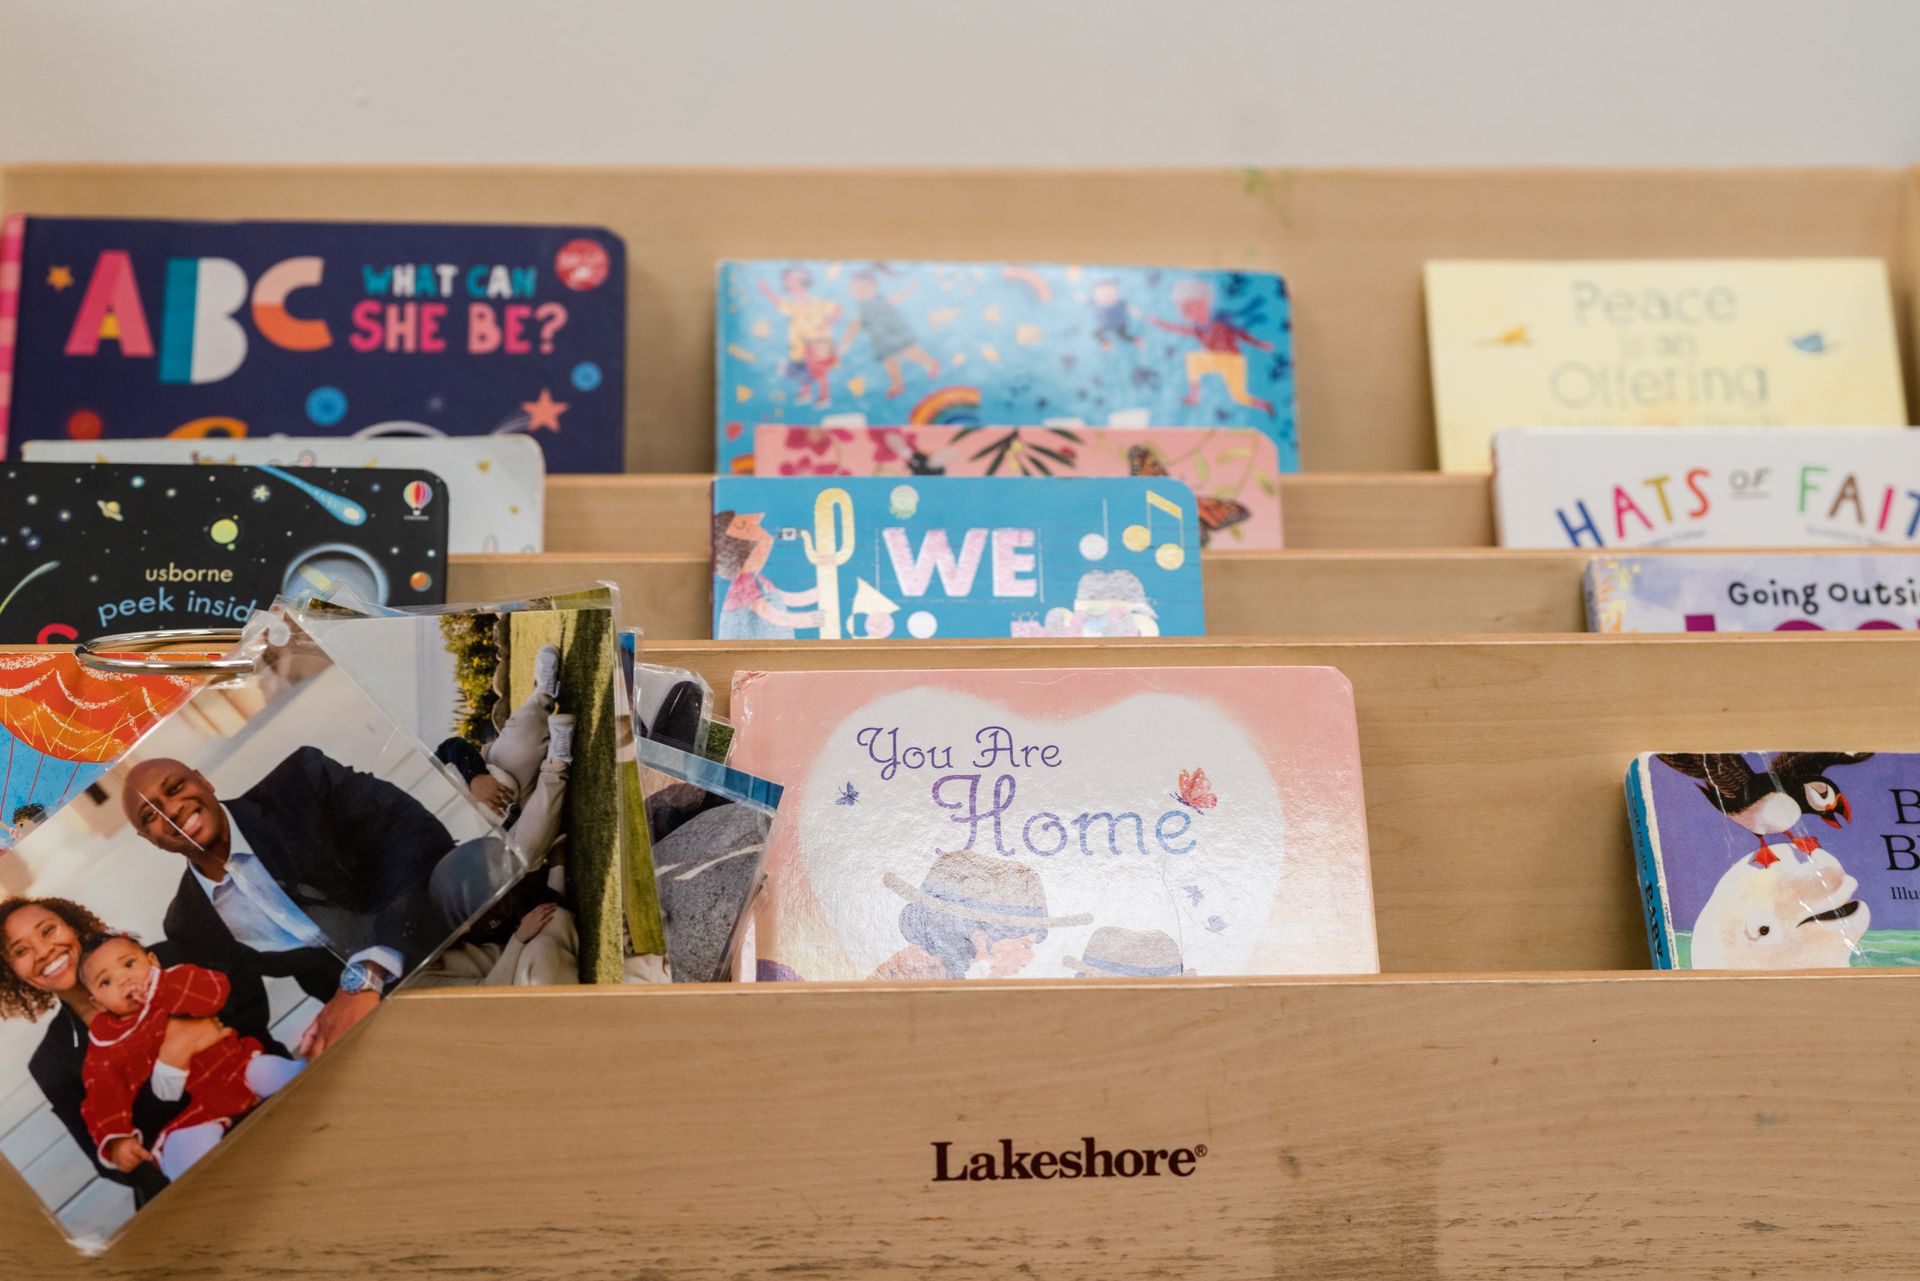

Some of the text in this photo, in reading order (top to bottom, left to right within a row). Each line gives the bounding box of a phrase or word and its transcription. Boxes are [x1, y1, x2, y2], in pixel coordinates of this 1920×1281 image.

[361, 263, 459, 298] WHAT
[465, 264, 537, 299] CAN
[1570, 279, 1740, 327] Peace
[64, 250, 334, 384] ABC
[349, 299, 569, 354] SHE BE?
[1549, 360, 1771, 412] Offering
[1555, 467, 1713, 548] HATS
[1799, 465, 1920, 540] FAIT
[145, 562, 234, 583] usborne
[882, 527, 1037, 597] WE
[98, 586, 258, 628] peek insid
[1728, 578, 1920, 616] Going Outsi
[856, 726, 1063, 781] You Are
[930, 774, 1197, 857] Home
[1880, 834, 1920, 871] B
[1890, 886, 1920, 900] Illu
